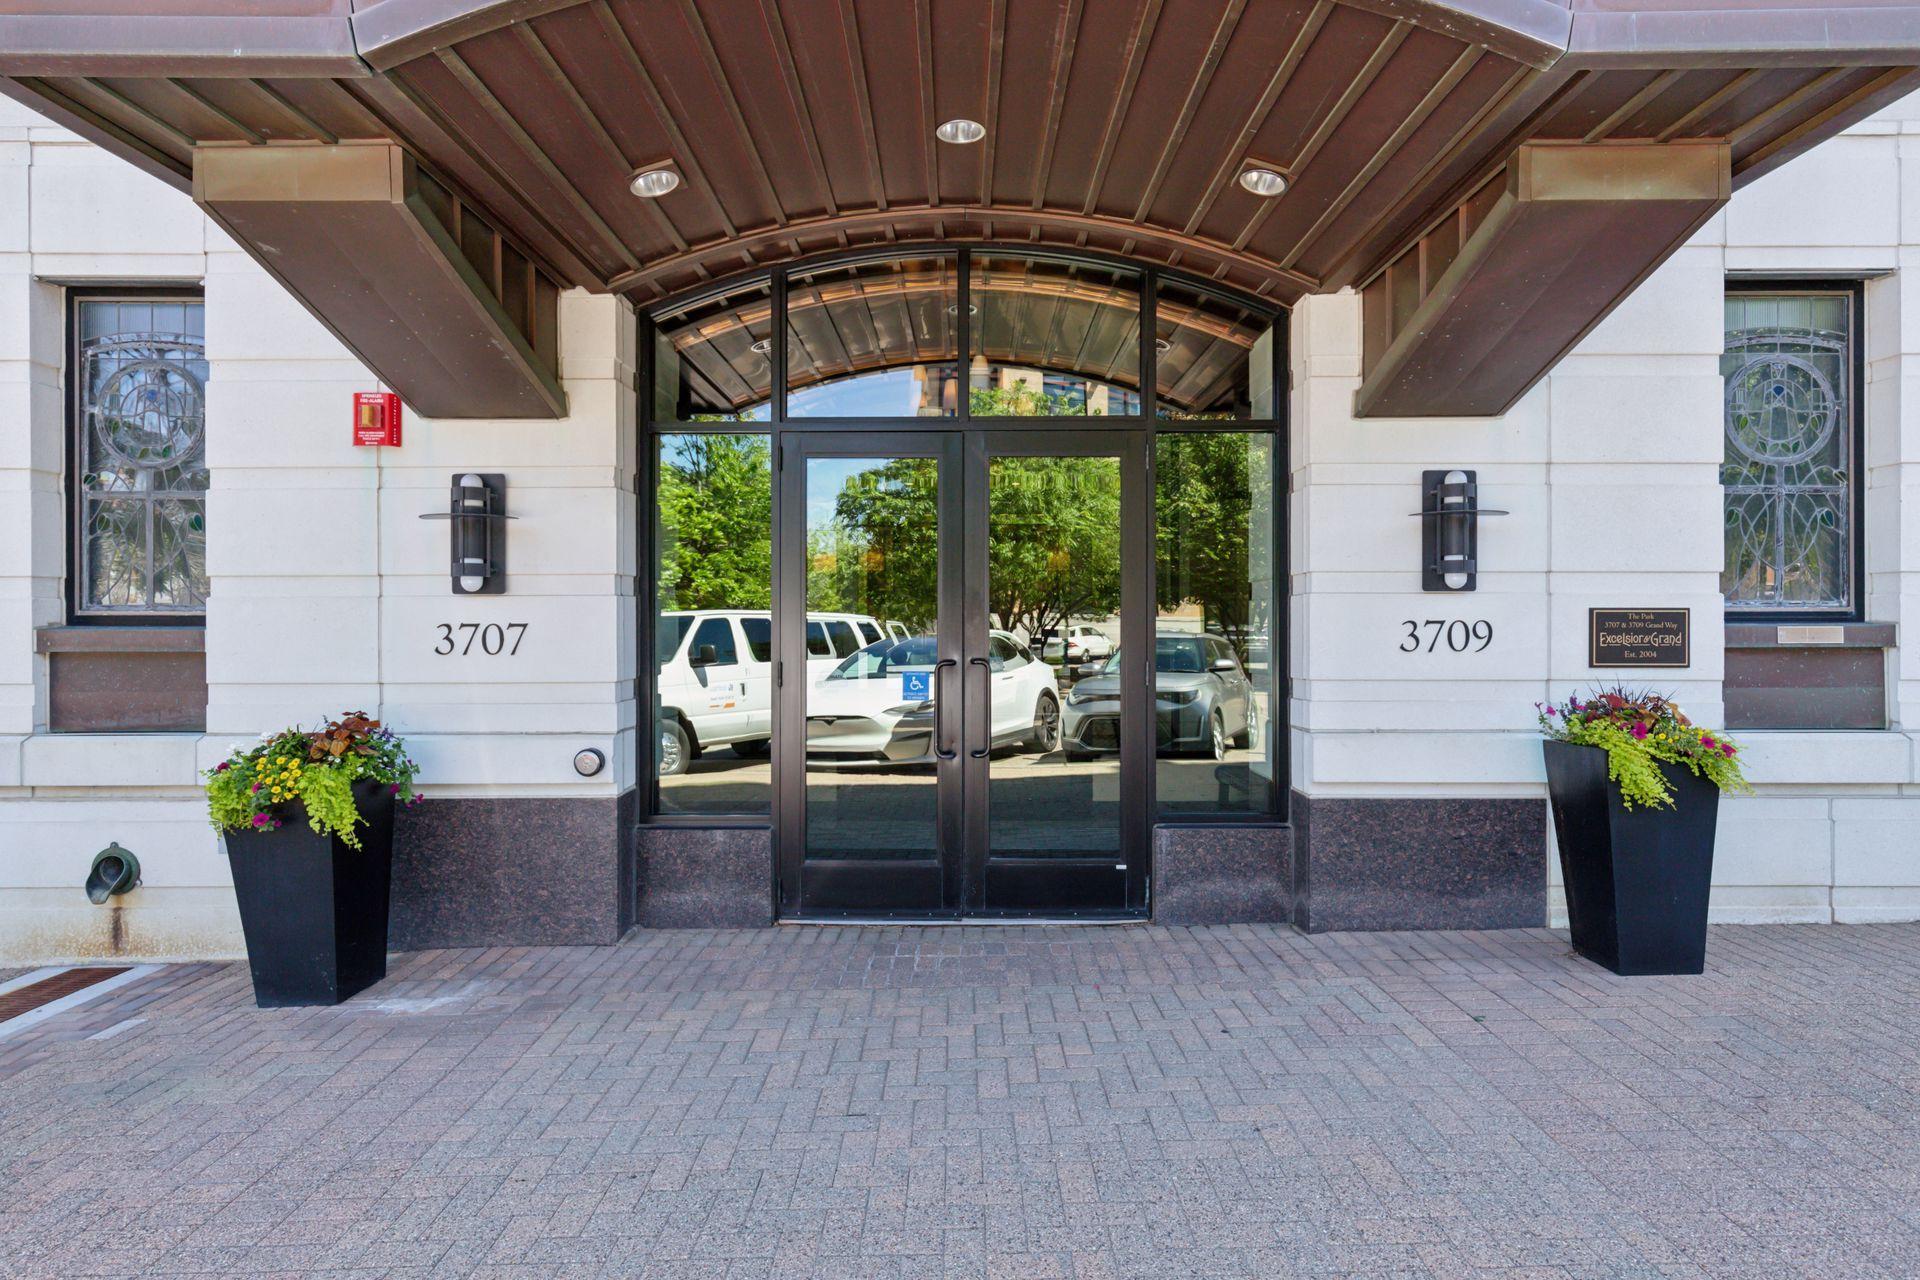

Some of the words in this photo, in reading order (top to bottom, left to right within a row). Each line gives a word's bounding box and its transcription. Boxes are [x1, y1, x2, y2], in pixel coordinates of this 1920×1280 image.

[1604, 621, 1620, 629] 3707
[1621, 621, 1627, 629] &
[1628, 621, 1644, 629] 3709
[1645, 621, 1664, 629] Grand
[1665, 621, 1678, 630] Way
[434, 622, 529, 656] 3707
[1399, 619, 1493, 653] 3709
[1651, 631, 1682, 647] Grand
[1624, 650, 1638, 658] Est.
[1639, 650, 1657, 658] 2004
